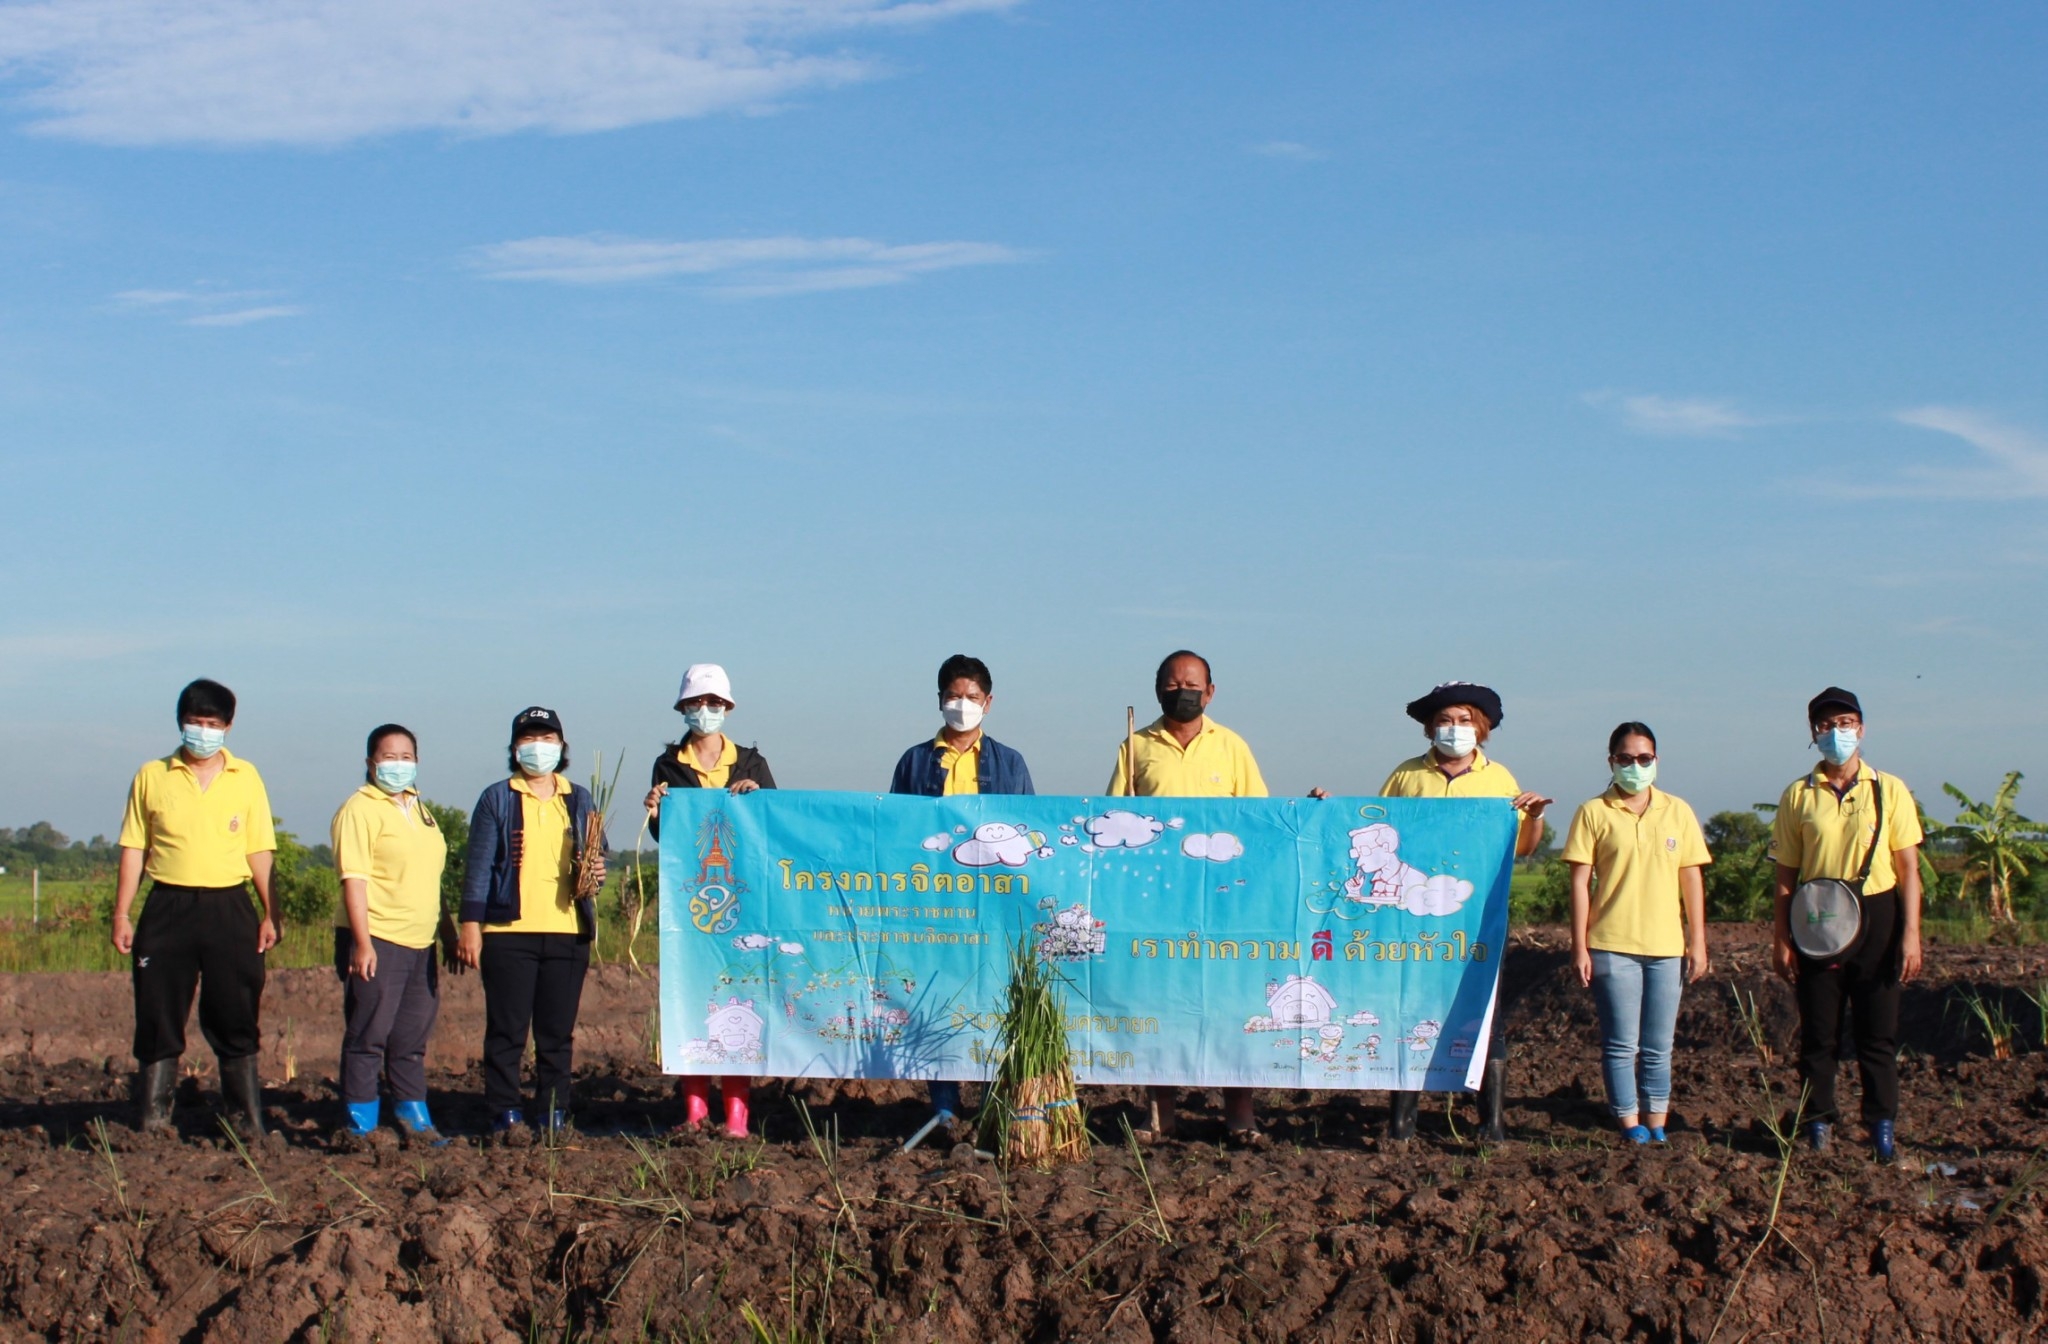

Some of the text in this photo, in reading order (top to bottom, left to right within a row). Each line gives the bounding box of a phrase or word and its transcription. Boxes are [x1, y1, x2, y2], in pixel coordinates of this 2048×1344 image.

[777, 858, 1030, 895] โครงการจิตอาสา
[1130, 929, 1488, 962] เราทำความ ดี ด้วยหัวใจ
